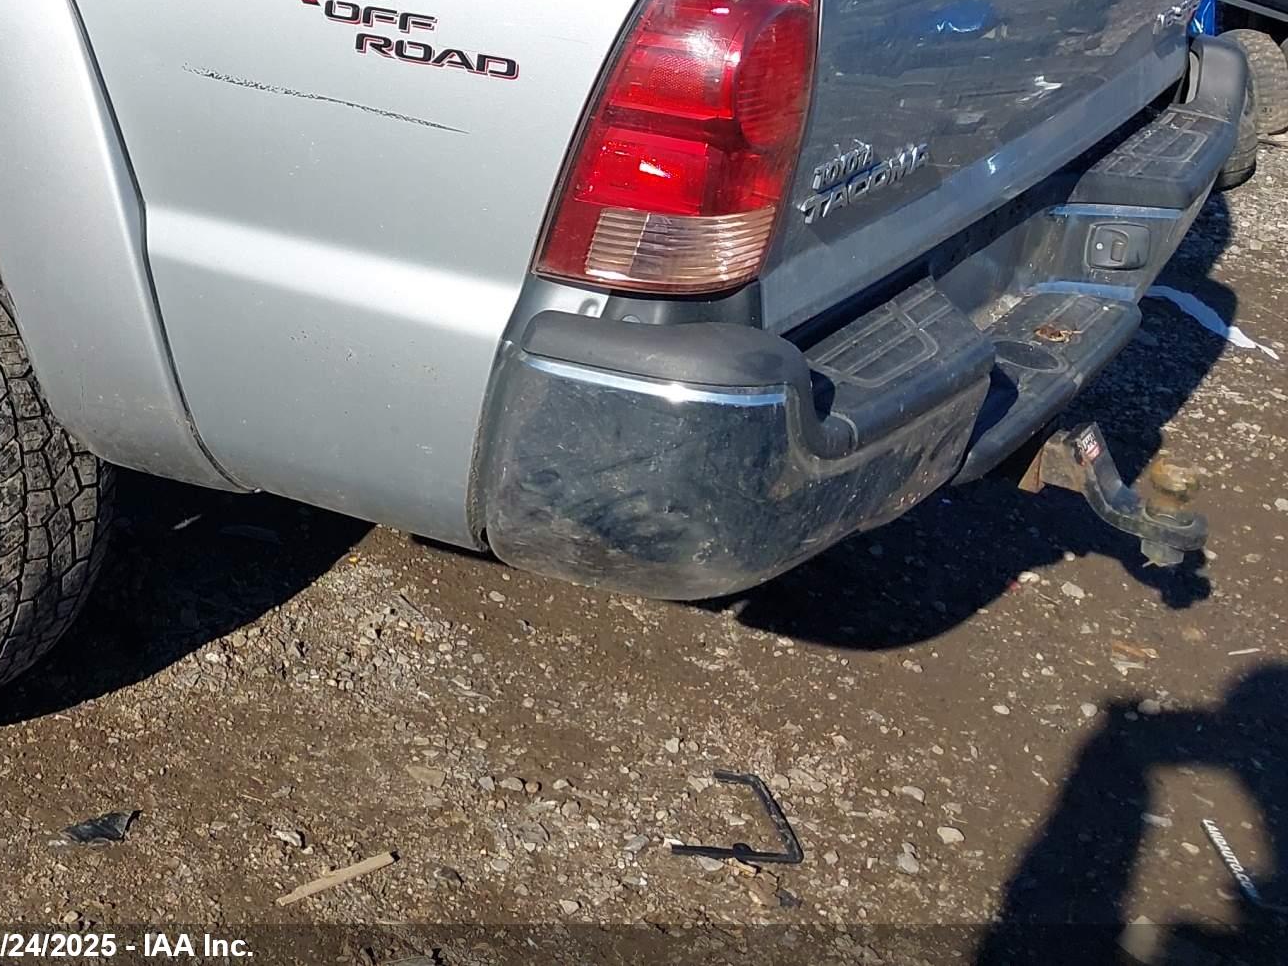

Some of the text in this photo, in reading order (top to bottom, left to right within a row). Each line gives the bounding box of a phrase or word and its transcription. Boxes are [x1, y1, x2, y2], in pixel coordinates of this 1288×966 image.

[323, 0, 439, 33] OFF
[354, 33, 520, 80] ROAD
[797, 143, 928, 224] TACOMA
